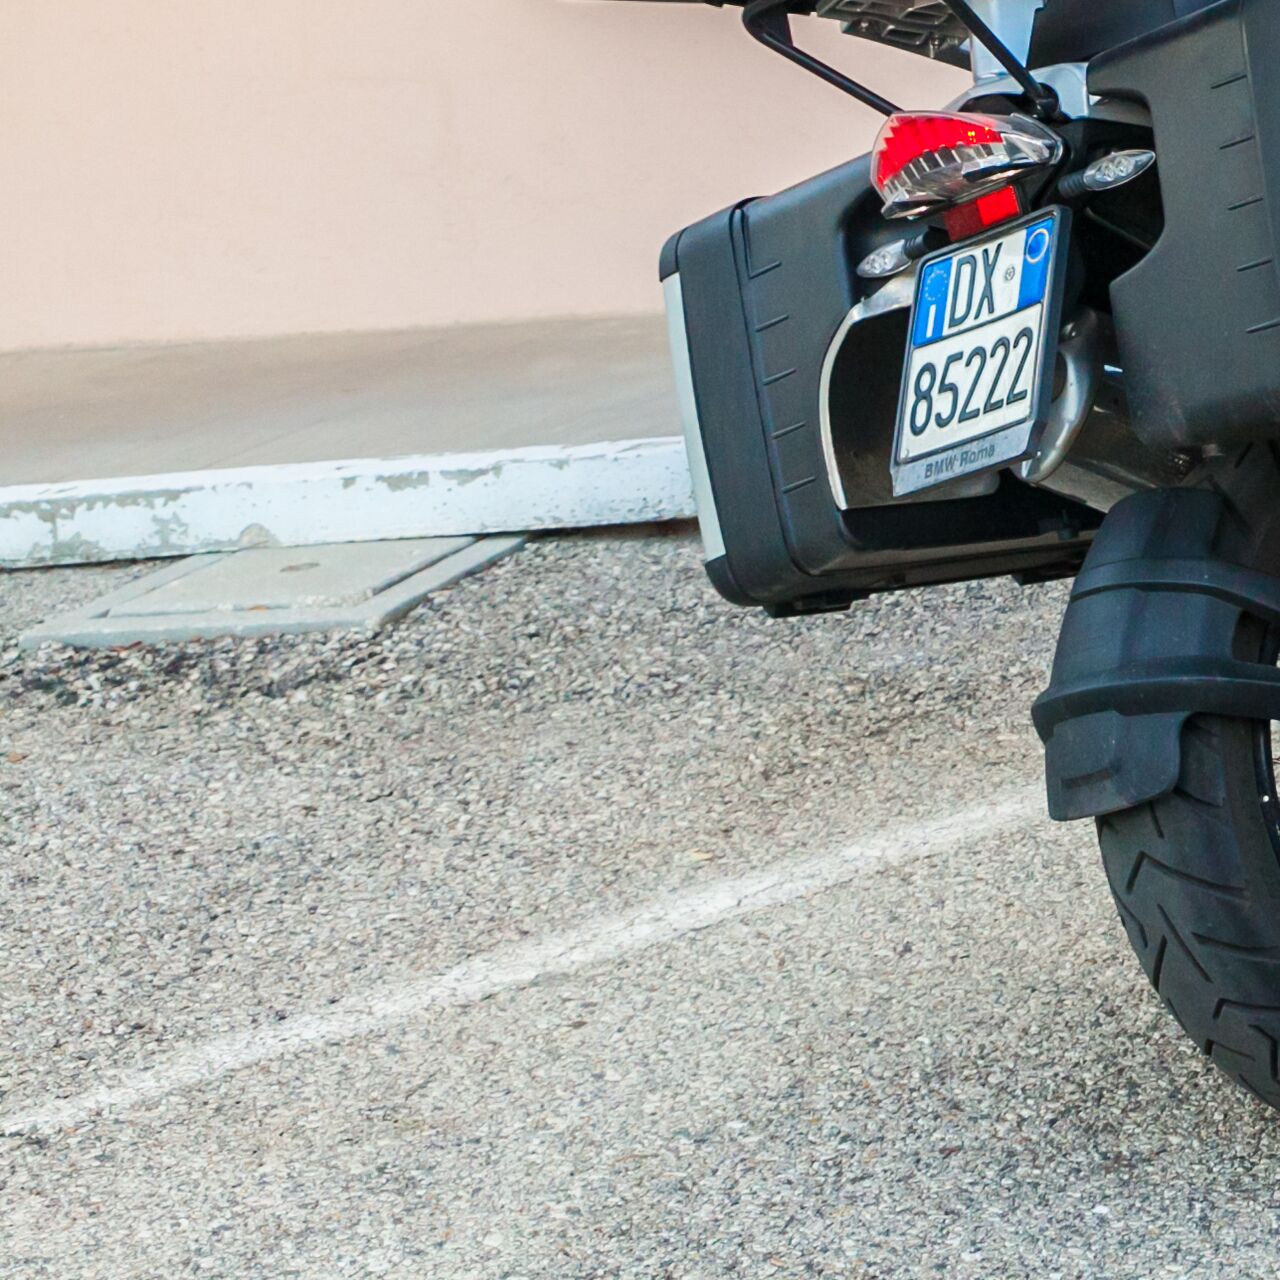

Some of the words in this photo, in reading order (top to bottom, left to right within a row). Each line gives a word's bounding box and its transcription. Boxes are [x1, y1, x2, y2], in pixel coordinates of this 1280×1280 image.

[949, 242, 1003, 328] DX
[910, 326, 1034, 438] 85222
[924, 454, 957, 479] BMW
[959, 444, 996, 467] Roma
